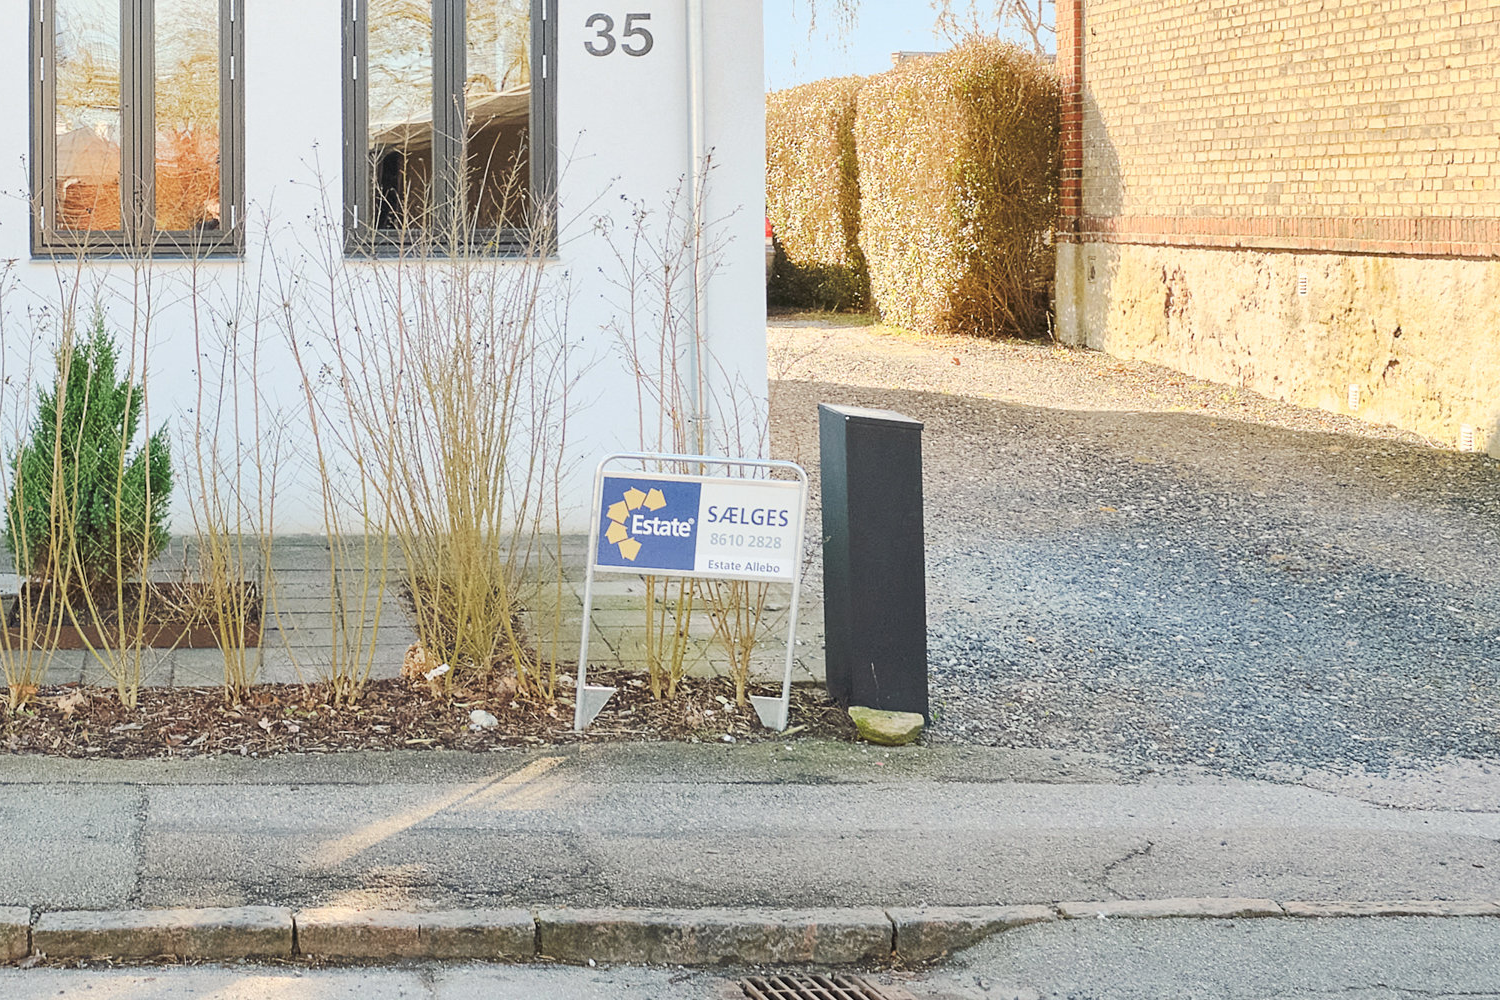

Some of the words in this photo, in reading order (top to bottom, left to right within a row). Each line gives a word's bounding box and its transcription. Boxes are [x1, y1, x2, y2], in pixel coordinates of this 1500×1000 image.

[583, 12, 654, 57] 35
[631, 514, 691, 538] Estate
[707, 505, 789, 527] SÆLGES
[710, 532, 744, 547] 8610
[747, 535, 782, 549] 2828
[708, 559, 741, 571] Estate
[744, 561, 781, 573] Allebo
